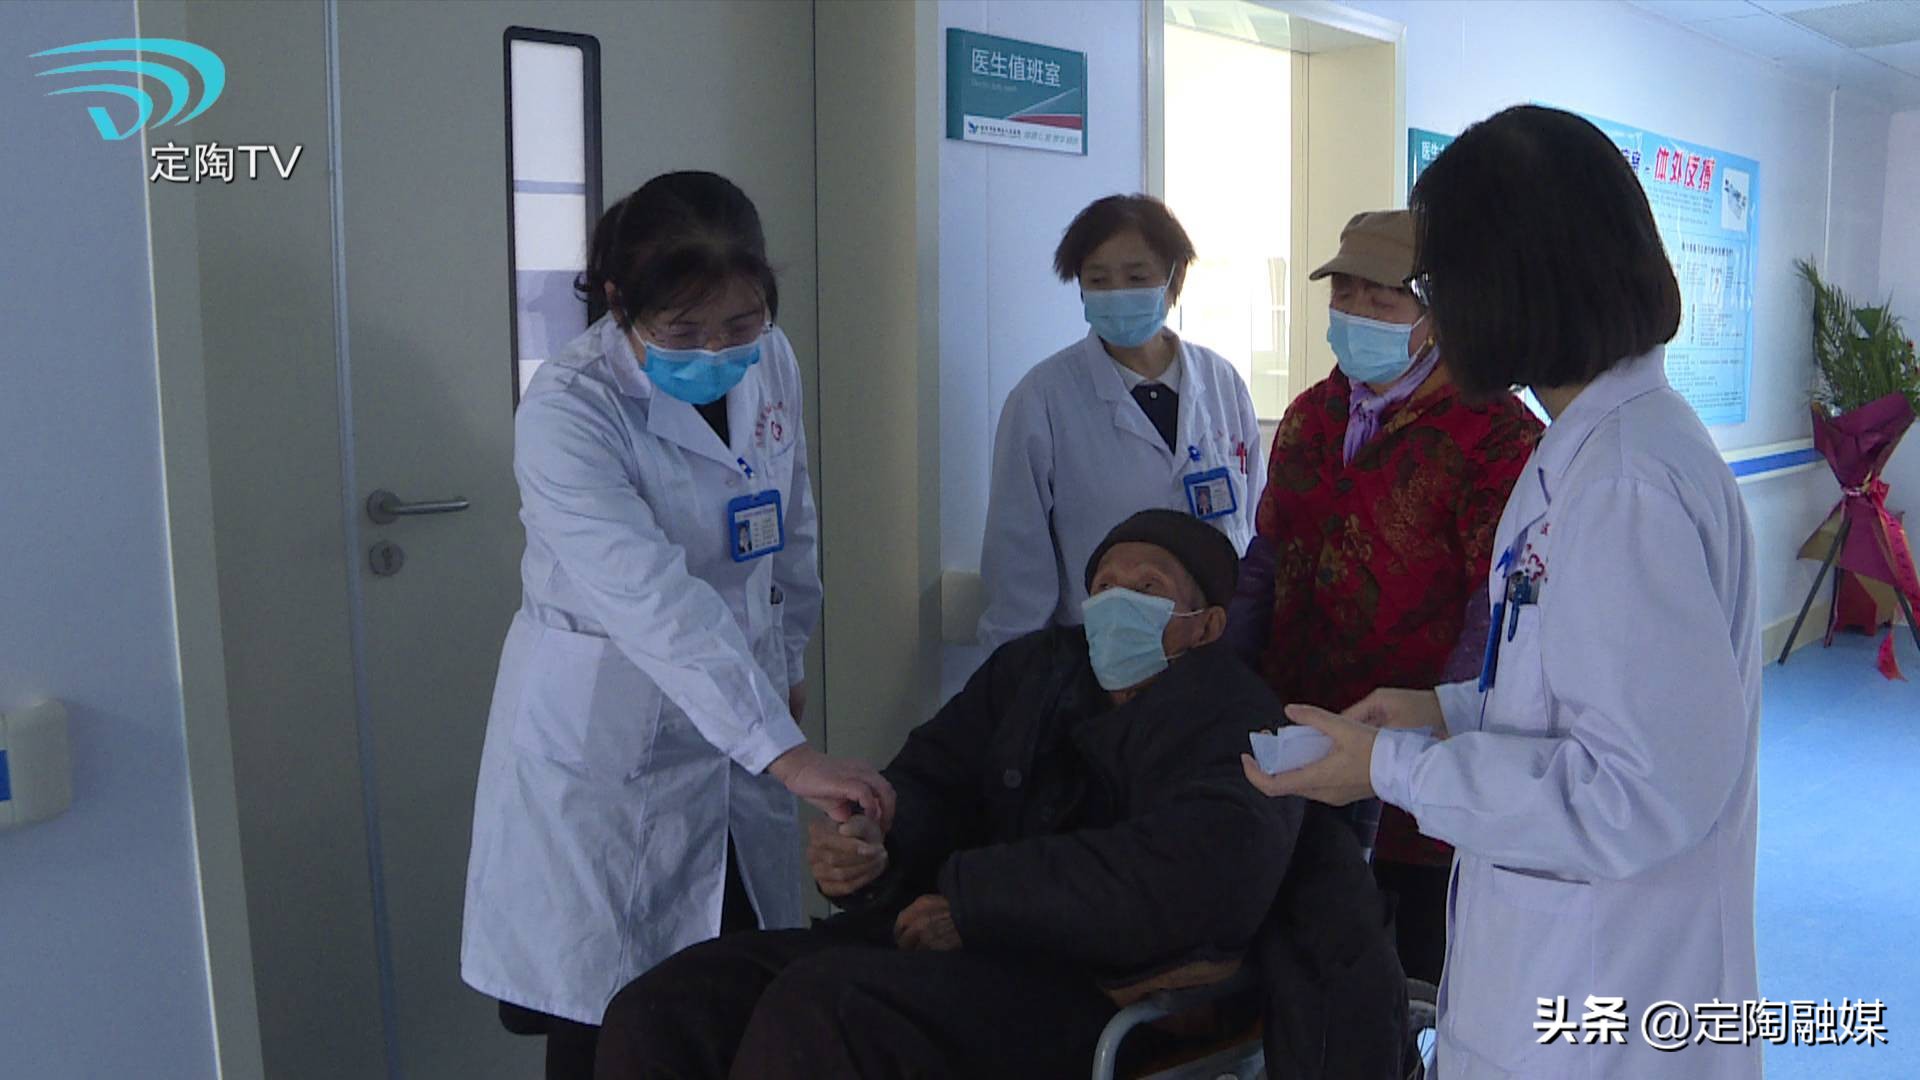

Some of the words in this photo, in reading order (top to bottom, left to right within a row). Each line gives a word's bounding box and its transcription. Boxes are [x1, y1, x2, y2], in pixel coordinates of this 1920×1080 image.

[972, 48, 1061, 87] 医生值班室
[1422, 141, 1445, 161] 医生
